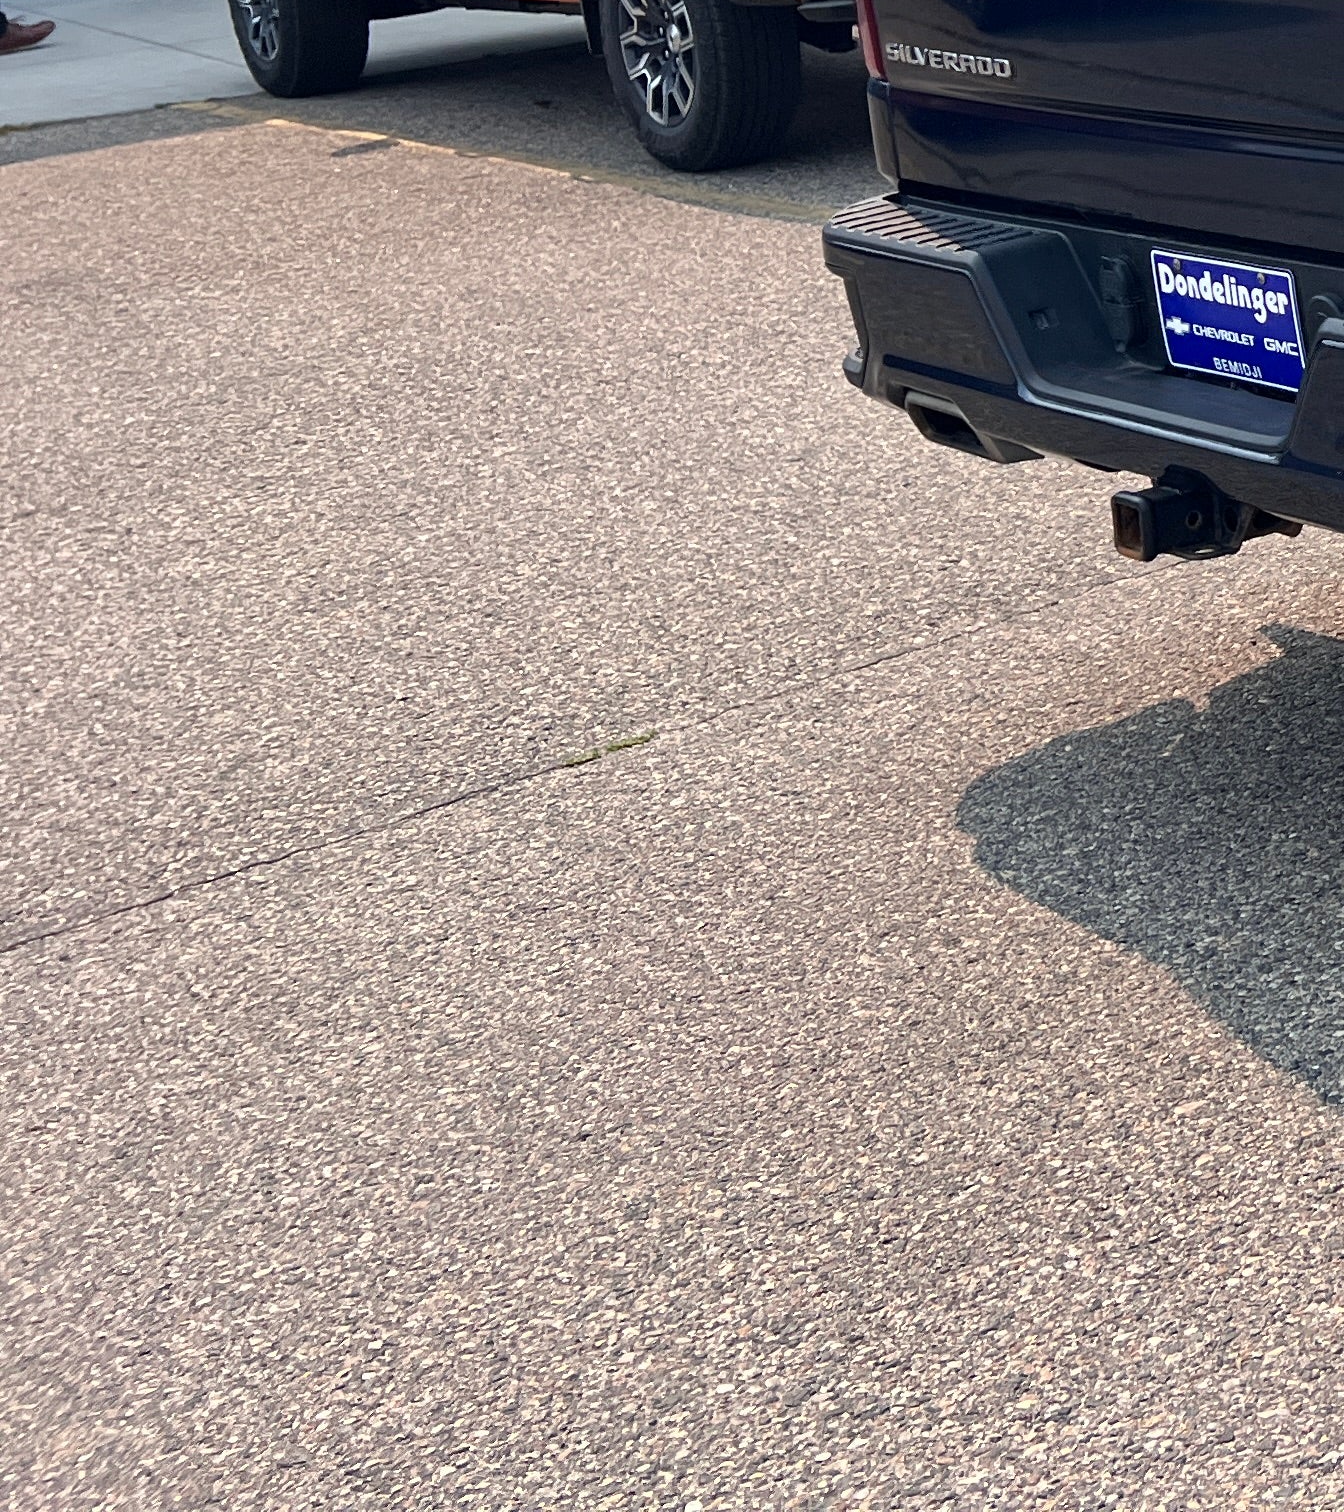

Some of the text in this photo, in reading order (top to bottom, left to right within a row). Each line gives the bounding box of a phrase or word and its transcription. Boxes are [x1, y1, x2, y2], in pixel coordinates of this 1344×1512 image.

[885, 42, 1013, 78] SILVERADO
[1157, 262, 1289, 324] Dondelinger
[1192, 323, 1299, 356] CHEVROLET GMC
[1212, 356, 1263, 379] BEMIDJI
